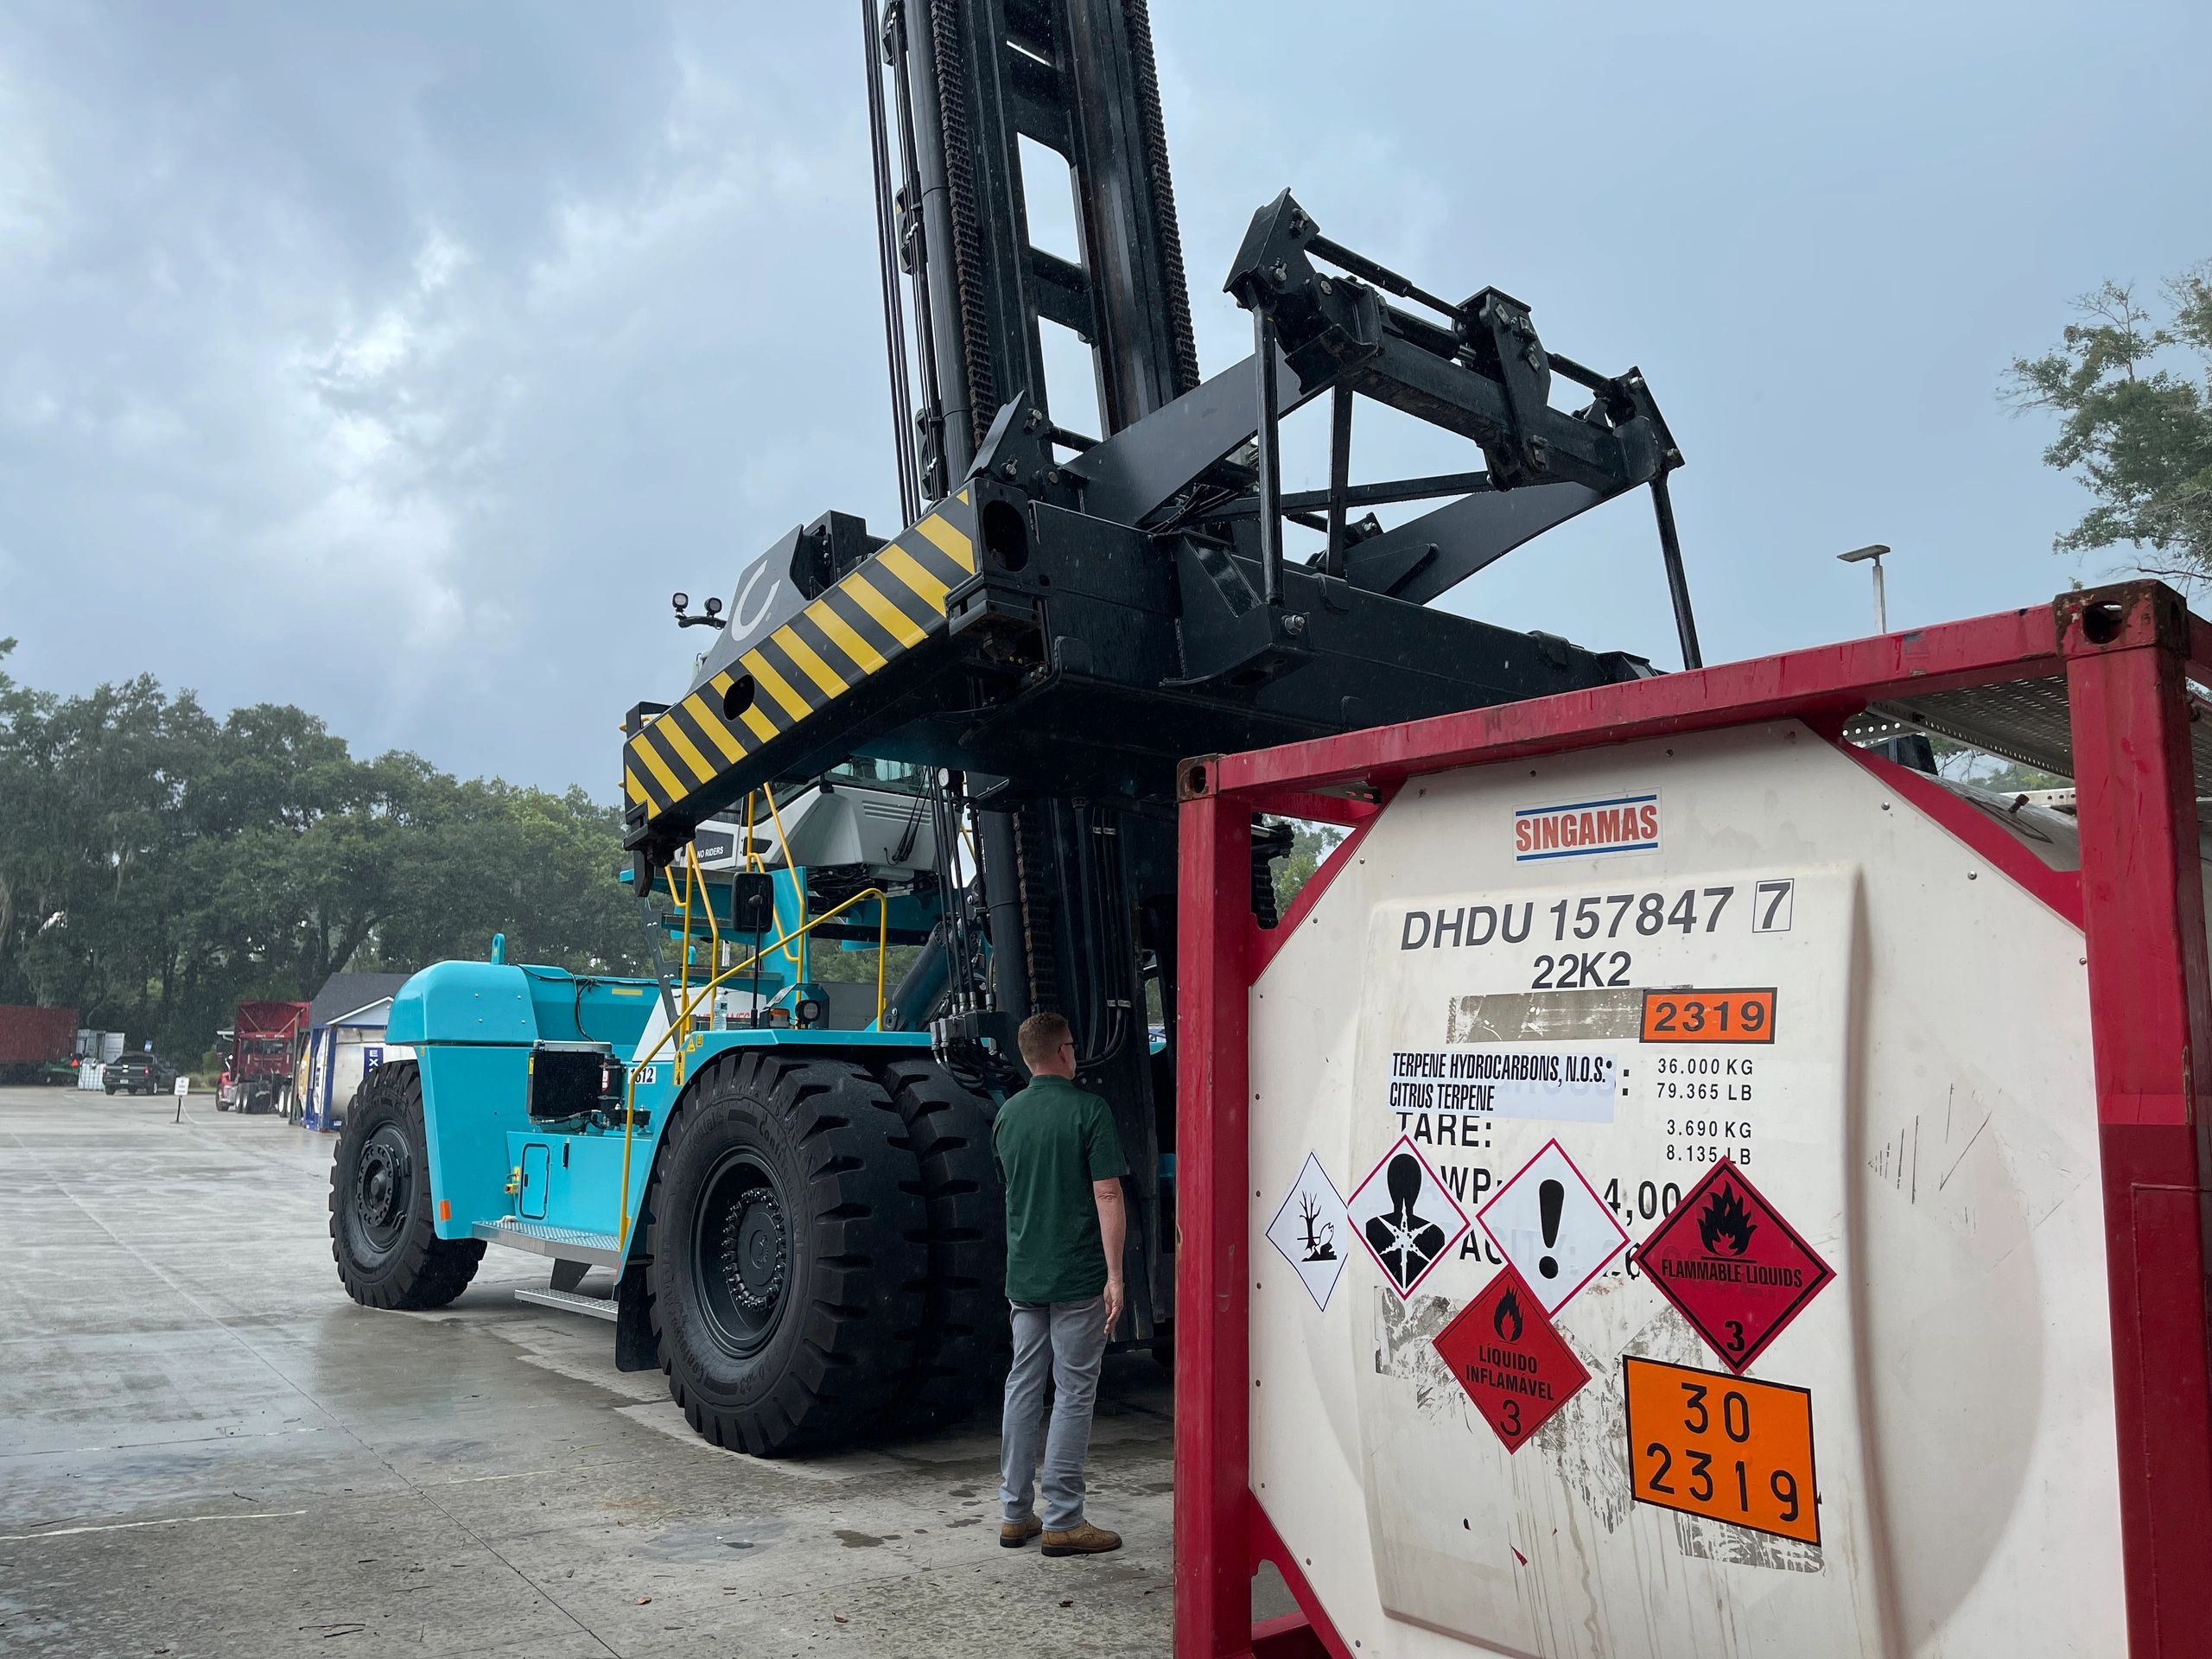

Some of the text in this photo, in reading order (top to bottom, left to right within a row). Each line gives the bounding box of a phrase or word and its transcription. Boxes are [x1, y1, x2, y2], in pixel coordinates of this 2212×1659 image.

[1516, 804, 1658, 851] SINGAMAS
[696, 846, 724, 859] NO RIDERS
[1401, 881, 1791, 950] DHDU 157847 7
[1531, 951, 1632, 989] 22K2
[1654, 1001, 1765, 1032] 2319
[1392, 1052, 1447, 1078] TERPENE
[1450, 1053, 1562, 1087] HYDROCARBONS,
[1658, 1058, 1752, 1075] 36.000 KG
[1389, 1082, 1495, 1111] CITRUS TERPENE
[1657, 1082, 1752, 1101] 79.365 LB
[1396, 1112, 1491, 1148] TARE:
[1667, 1119, 1751, 1138] 3.690 KG
[1667, 1144, 1751, 1165] 8.135 LB
[1661, 1259, 1741, 1282] FLAMMABLE
[1746, 1265, 1803, 1287] LIQUIDS
[1725, 1320, 1745, 1351] 3
[1478, 1343, 1538, 1374] LÍQUIDO
[1465, 1364, 1555, 1402] INFLAMÁVEL
[1499, 1399, 1522, 1437] 3
[1681, 1382, 1750, 1443] 30
[1646, 1443, 1799, 1522] 2319
